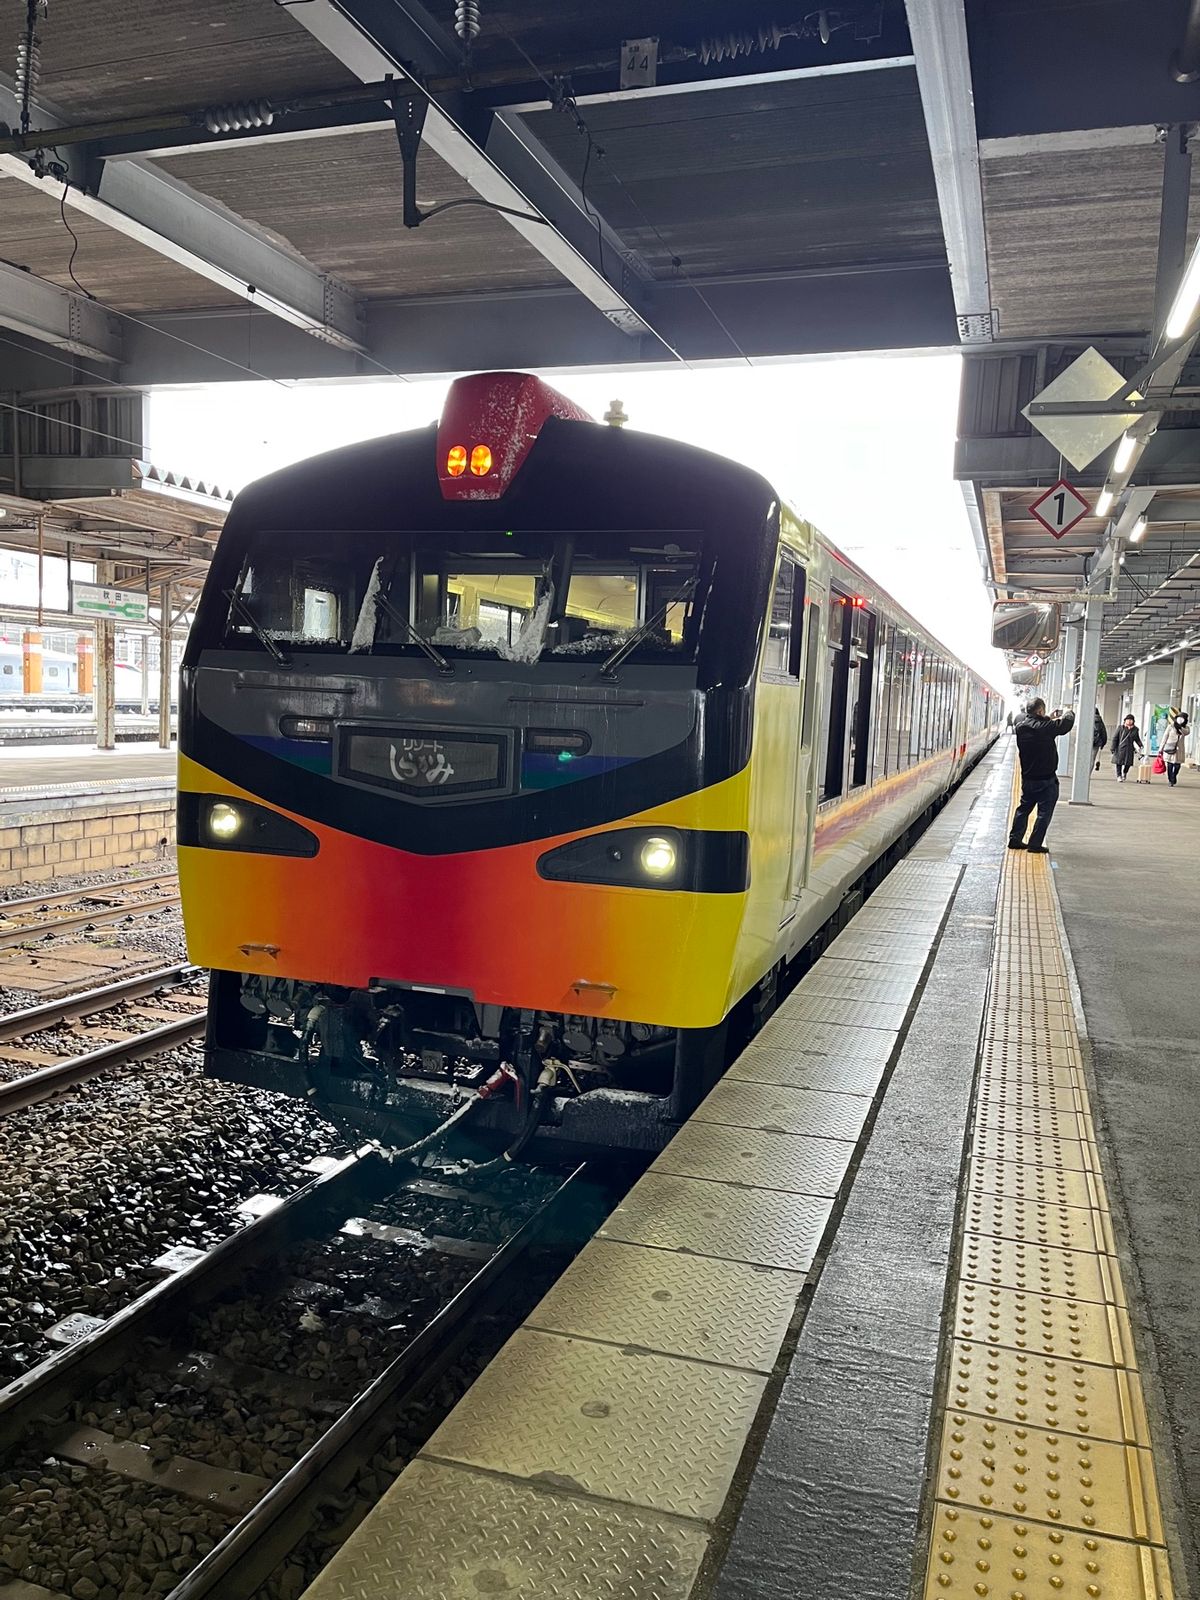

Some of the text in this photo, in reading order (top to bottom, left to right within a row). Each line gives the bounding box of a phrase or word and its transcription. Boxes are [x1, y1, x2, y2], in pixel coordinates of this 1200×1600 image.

[627, 55, 648, 71] 44
[1053, 492, 1065, 525] 1
[103, 590, 122, 601] 秋田
[1032, 656, 1039, 665] 2
